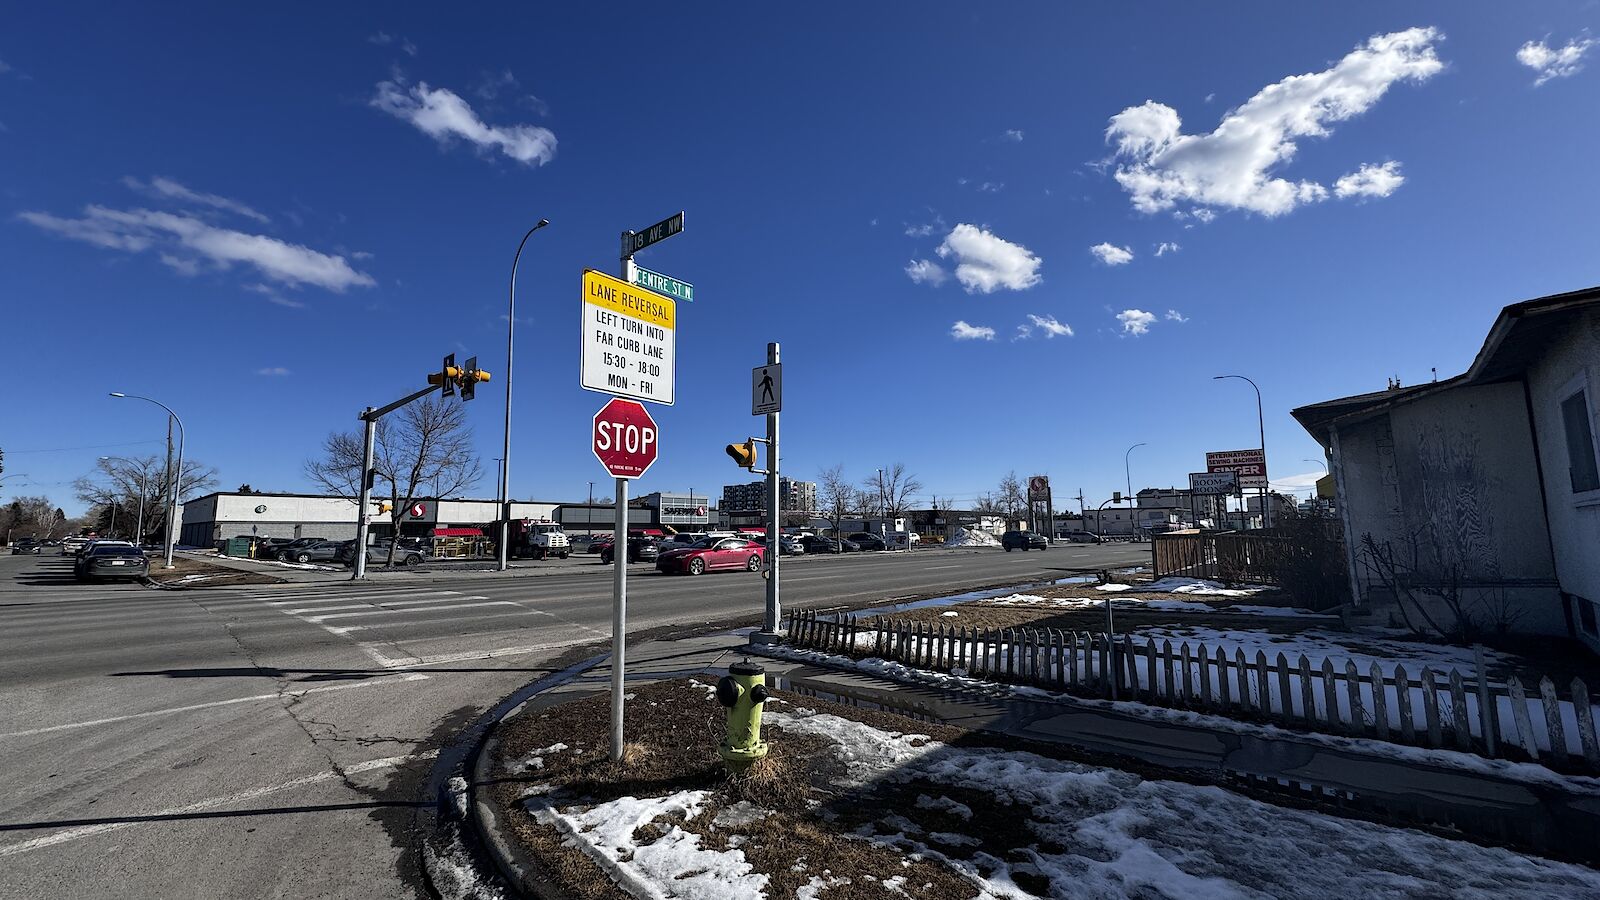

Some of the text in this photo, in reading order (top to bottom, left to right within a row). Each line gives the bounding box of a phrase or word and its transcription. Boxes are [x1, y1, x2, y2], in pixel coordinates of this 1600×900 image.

[633, 215, 682, 250] 18 AVE NW
[637, 268, 691, 300] CENTRE ST N
[591, 281, 669, 321] LANE REVERSAL
[596, 309, 664, 342] LEFT TURN INTO
[596, 329, 664, 360] FAR CURB LANE
[603, 351, 626, 370] 15:30
[638, 361, 660, 377] 18:00
[607, 373, 628, 390] MON
[640, 380, 653, 395] FRI
[597, 420, 655, 455] STOP
[1208, 451, 1263, 459] INTERNATIONAL
